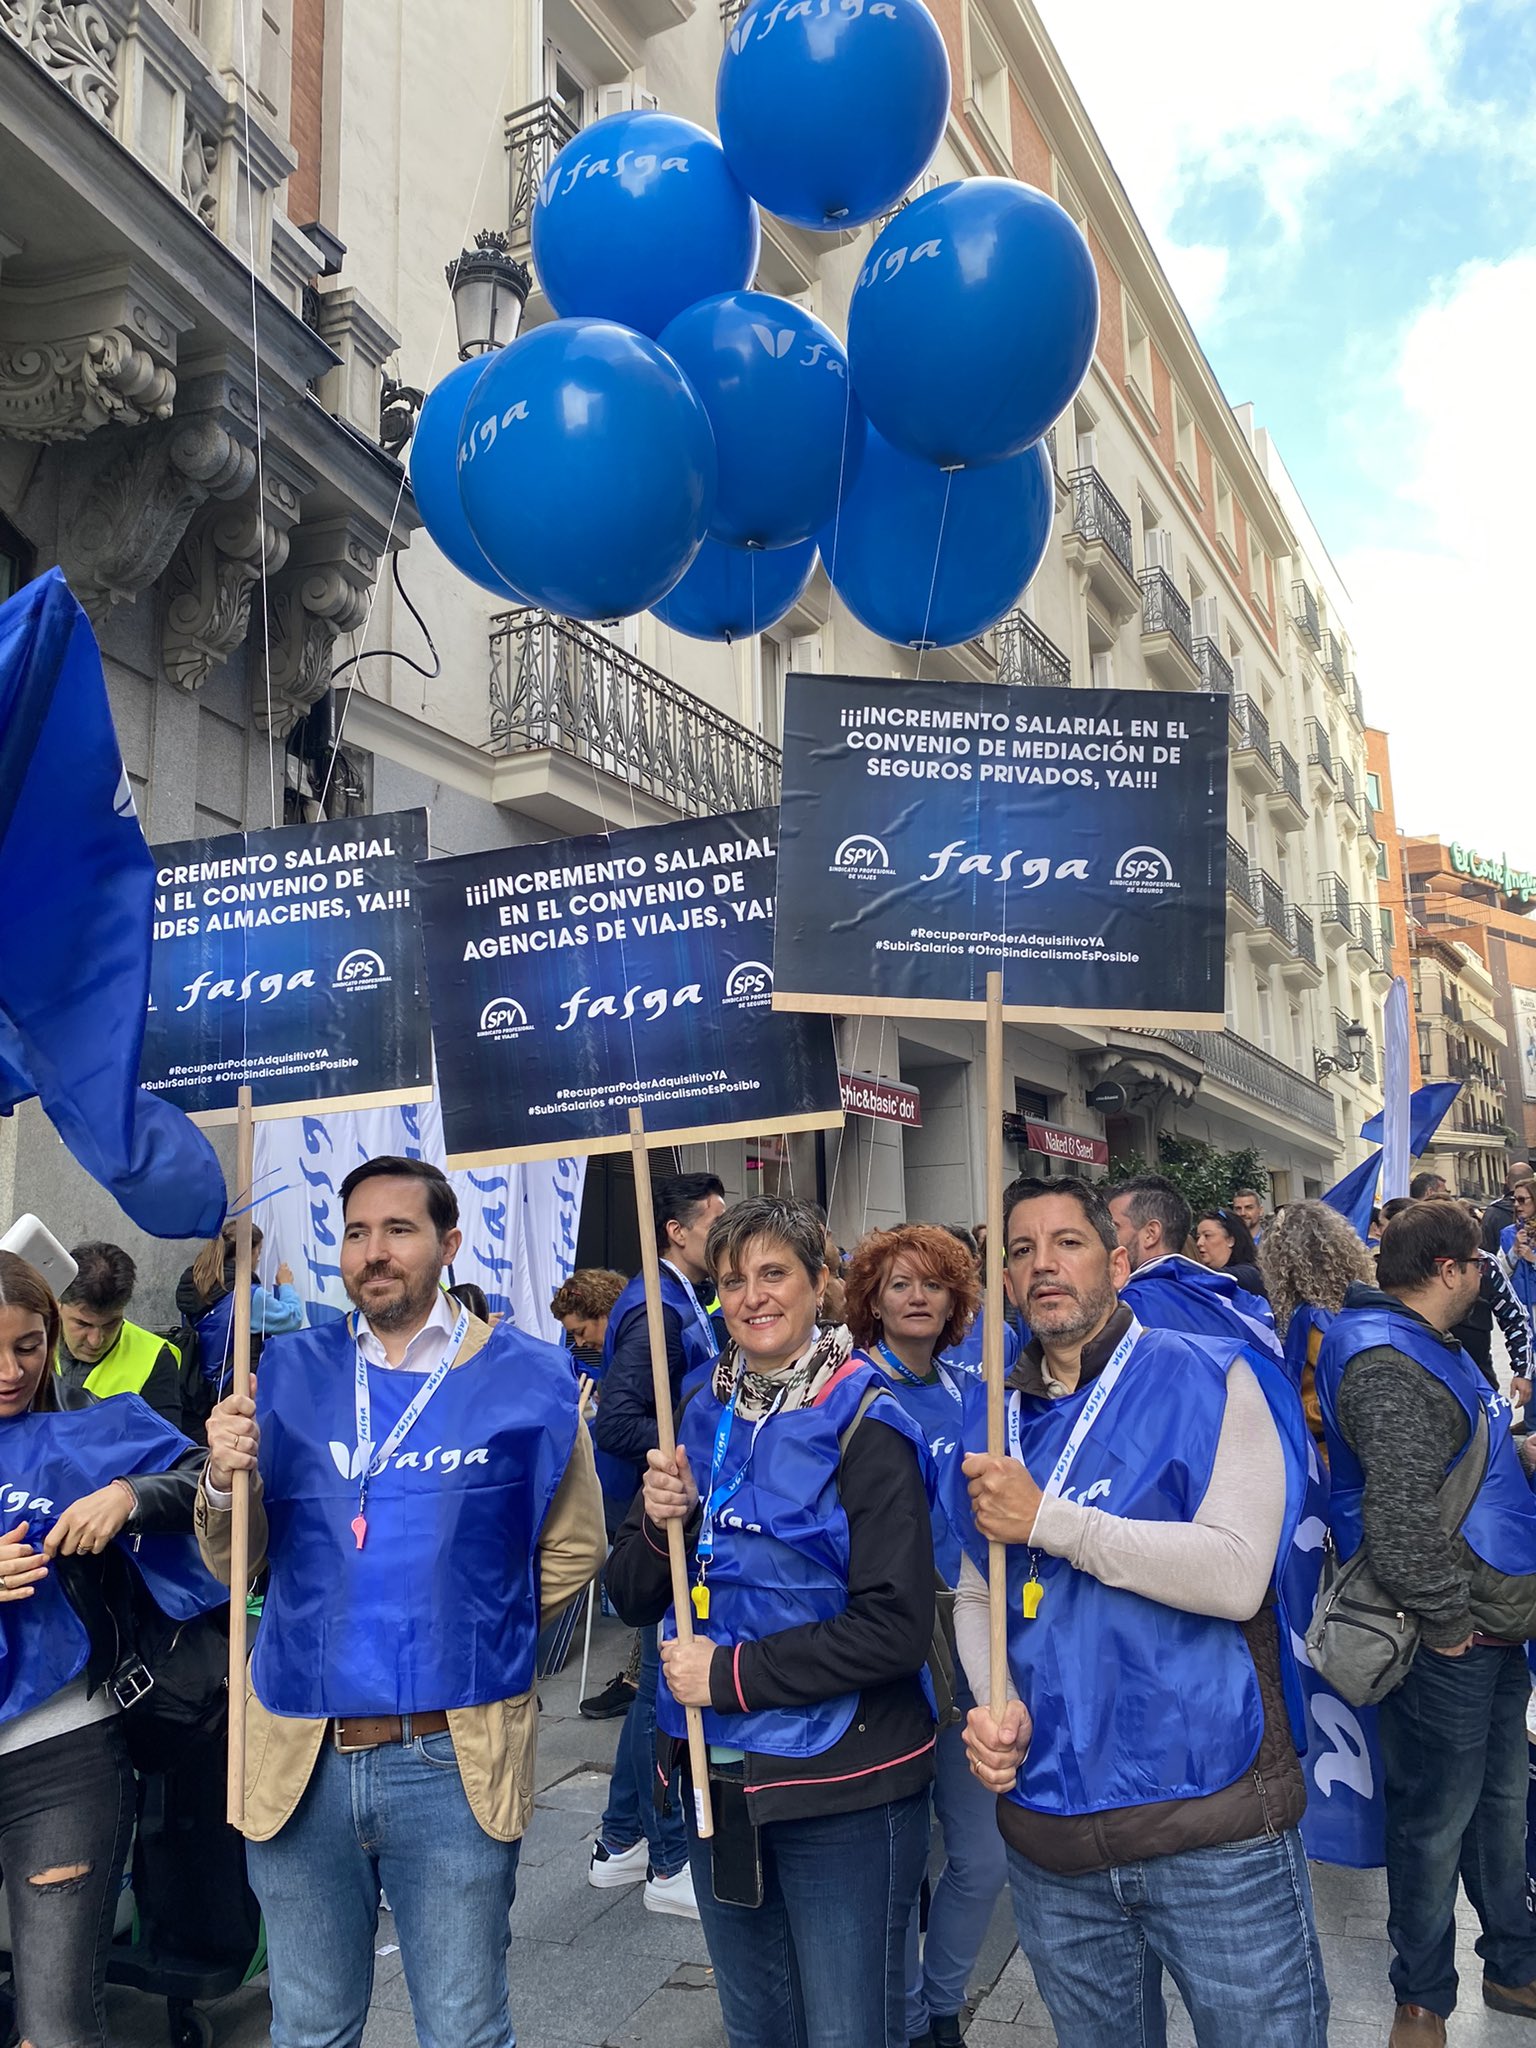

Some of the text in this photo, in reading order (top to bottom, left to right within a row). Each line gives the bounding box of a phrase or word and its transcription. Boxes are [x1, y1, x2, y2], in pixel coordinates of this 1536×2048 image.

[561, 150, 690, 196] fasga
[799, 343, 845, 379] fa
[1014, 714, 1125, 738] SALARIAL
[1130, 719, 1159, 738] EN
[1167, 721, 1190, 740] EL
[846, 731, 1181, 765] CONVENIO DE MEDIACIÓN DE
[866, 757, 1158, 790] SEGUROS PRIVADOS, YA!!!
[156, 837, 396, 888] CREMENTO SALARIAL
[654, 836, 777, 874] SALARIAL
[841, 847, 880, 866] SPV
[859, 867, 897, 875] PROFESIONAL
[919, 839, 1090, 889] fasga
[1123, 859, 1161, 880] SPS
[154, 867, 364, 914] N EL CONVENIO DE
[499, 870, 745, 928] EN EL CONVENIO DE
[1141, 880, 1181, 888] PROFESIONAL
[205, 897, 351, 933] ALMACENES,
[357, 888, 411, 914] YA!!!
[463, 896, 777, 962] AGENCIAS DE VIAJES, YA!
[910, 927, 1106, 949] #RecuperarPoderAdquisitivoYA
[875, 939, 1140, 964] #SubirSalarios #OtroSindicalismoEsPosible
[343, 960, 375, 980] SPS
[732, 973, 766, 995] SPS
[175, 968, 316, 1013] fasga
[554, 982, 704, 1032] fasga
[486, 1008, 517, 1029] SPV
[140, 1056, 359, 1091] #SubirSalarios #OtroSindicalismoEsPosible
[168, 1048, 329, 1077] #RecuperarPoderAdquisitivoYA
[528, 1078, 761, 1117] #SubirSalarios #OtroSindicalismoEsPosible
[556, 1069, 728, 1100] #RecuperarPoderAdquisitivoYA
[899, 1097, 915, 1120] dot
[1044, 1131, 1068, 1154] Naked
[1075, 1139, 1095, 1160] Sated
[299, 1116, 343, 1294] fasg
[467, 1170, 513, 1288] fas
[1083, 1381, 1107, 1423] fasga
[1054, 1440, 1076, 1483] fasga
[0, 1483, 54, 1515] sga
